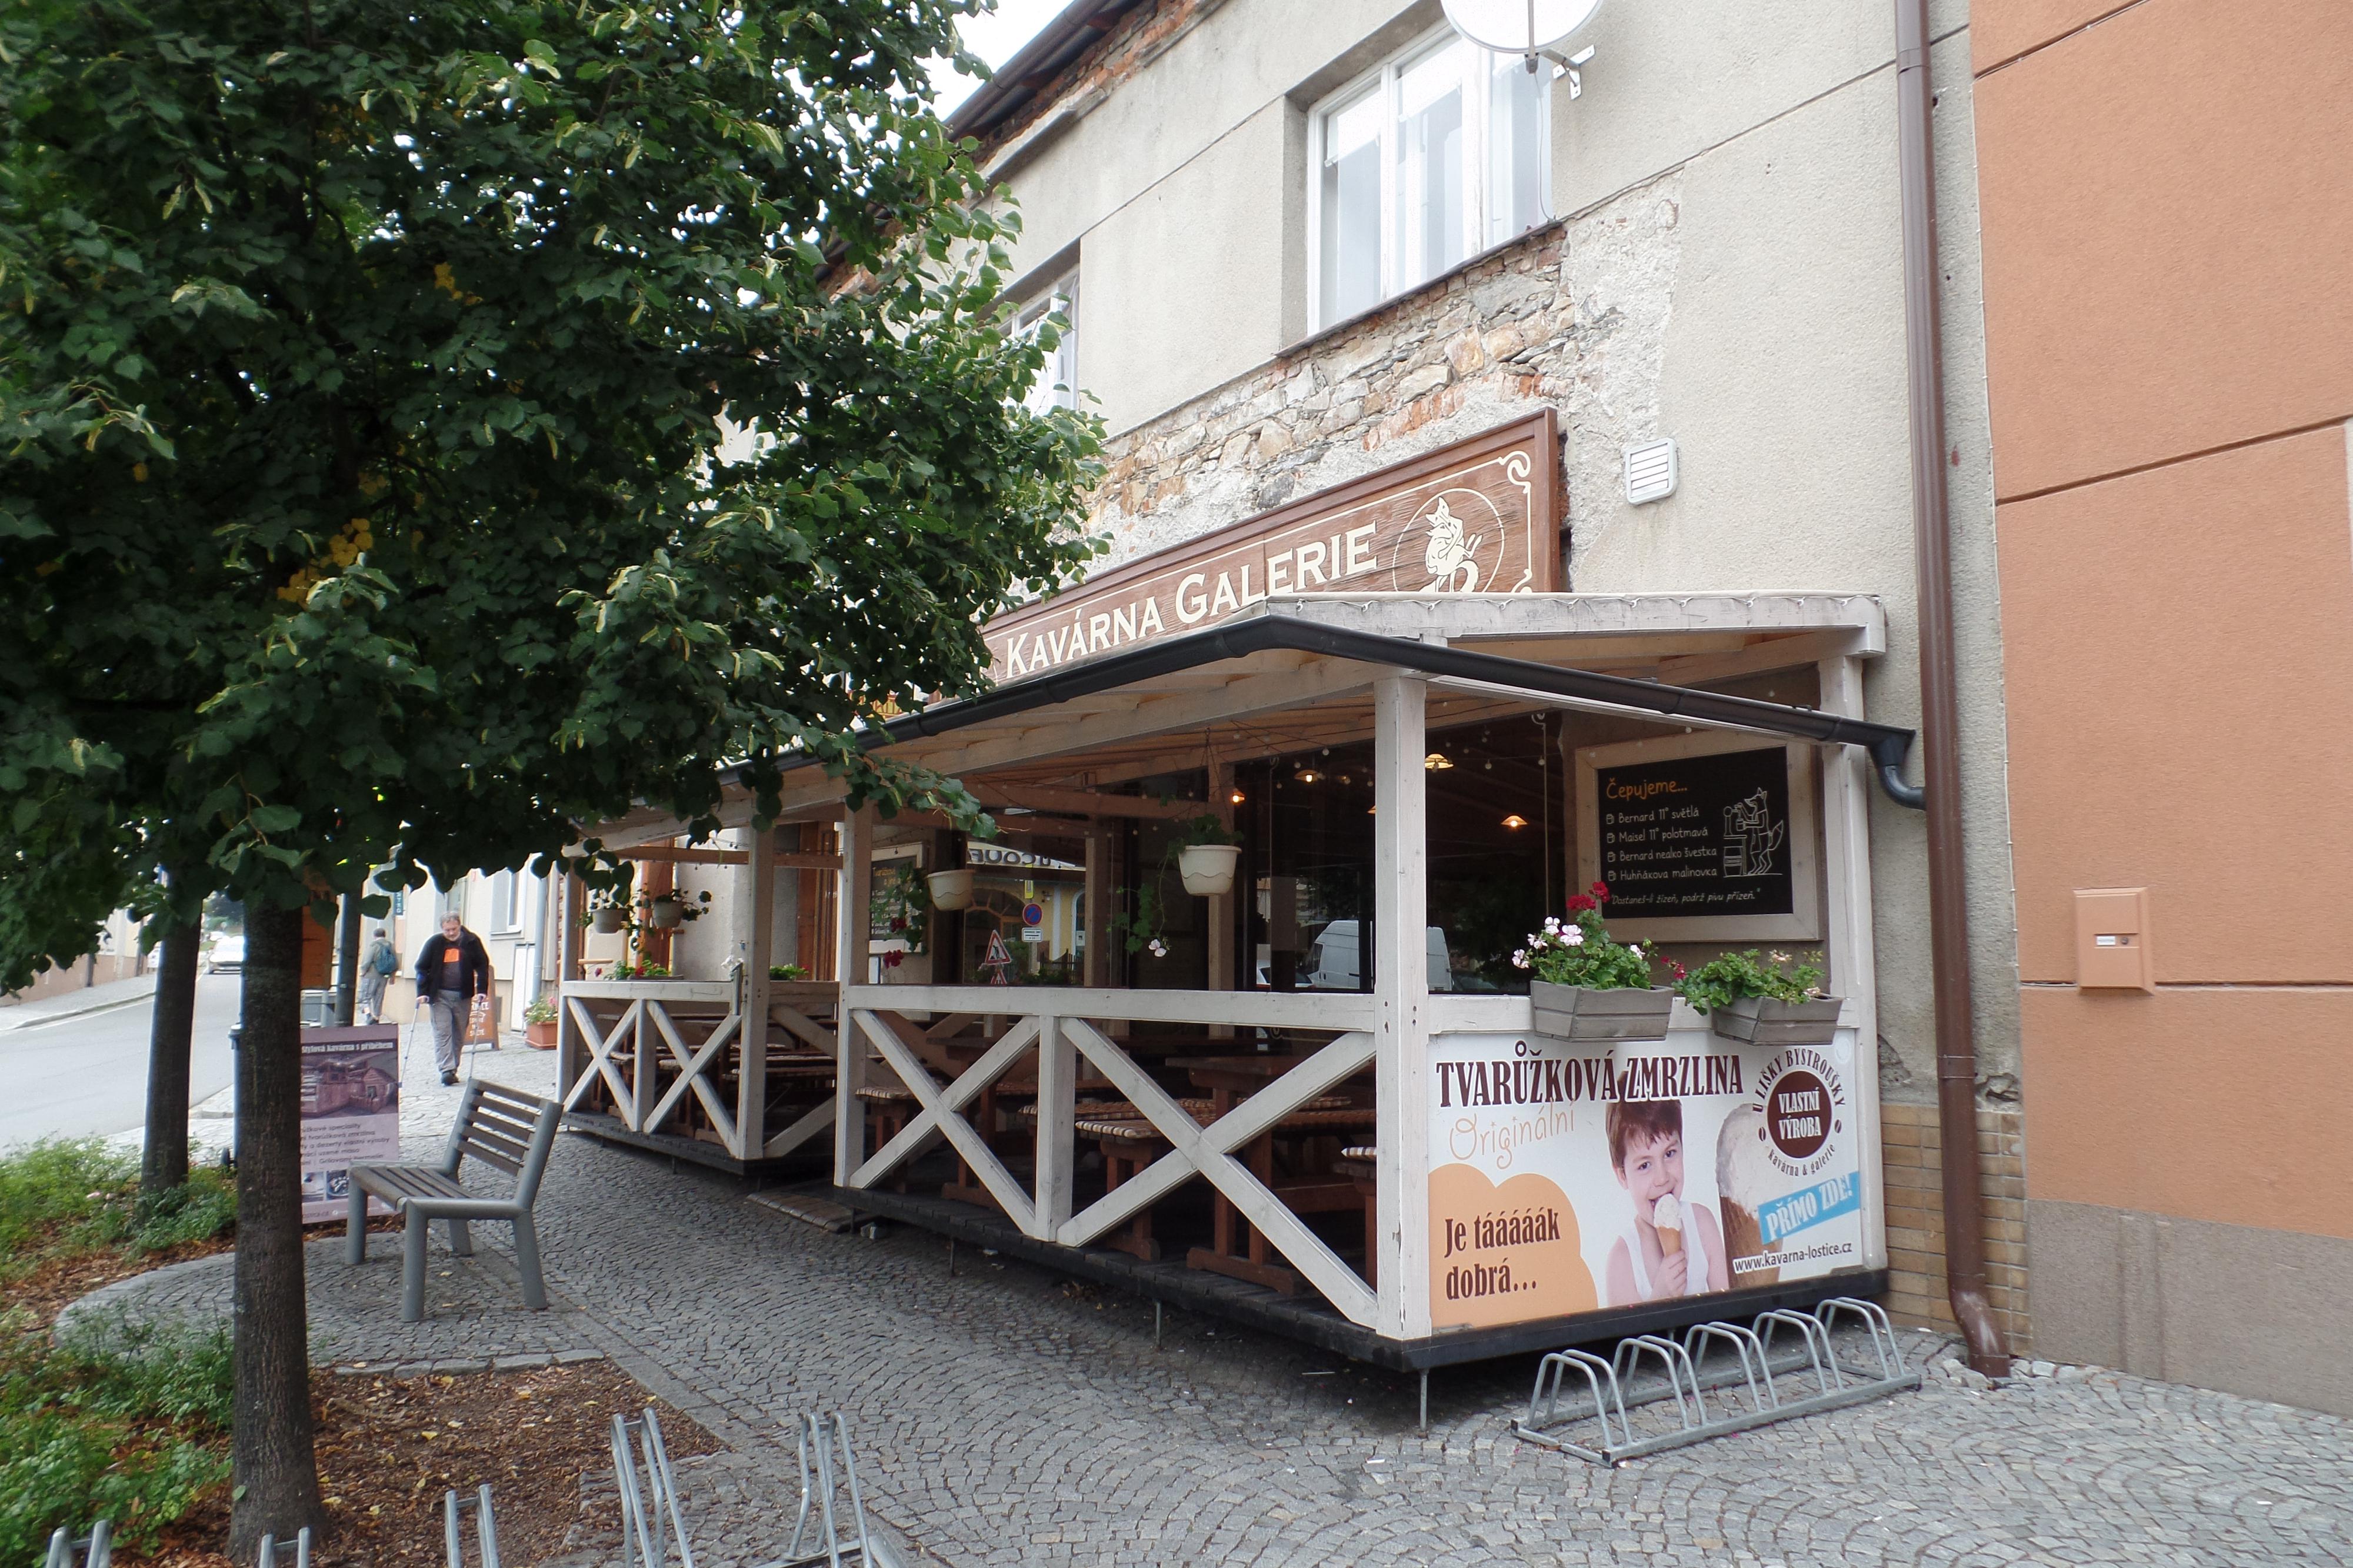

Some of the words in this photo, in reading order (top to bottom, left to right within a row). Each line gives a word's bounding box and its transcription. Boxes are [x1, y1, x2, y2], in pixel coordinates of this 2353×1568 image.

[1006, 596, 1165, 679] KAVÁRNA
[1175, 521, 1378, 623] GALERIE
[1607, 778, 1688, 800] Čepujeme...
[1618, 810, 1655, 823] Bernard
[1672, 805, 1699, 819] světlá
[1619, 829, 1645, 842] Maisel
[1662, 826, 1708, 842] polotmavá
[1619, 849, 1654, 861] Bernard
[1656, 846, 1681, 859] nealko
[1684, 846, 1717, 858] švestka
[1672, 865, 1718, 878] malinovka
[1436, 1040, 1618, 1107] TVARŮŽKOVÁ
[1625, 1055, 1744, 1099] ZMRZLINA
[1755, 1055, 1783, 1100] LIŠKY
[1785, 1049, 1845, 1106] BYSTROUŠKY
[1752, 1103, 1764, 1113] U
[1778, 1087, 1821, 1114] VLASTNÍ
[1449, 1097, 1575, 1170] Originální
[1778, 1115, 1822, 1140] VÝROBA
[1768, 1149, 1799, 1176] kavárna
[1802, 1165, 1808, 1176] &
[1811, 1144, 1835, 1175] galerie
[1765, 1192, 1818, 1241] PŘÍMO
[1819, 1175, 1853, 1210] ZDE!
[1444, 1218, 1467, 1258] Je
[1474, 1207, 1560, 1249] tááááák
[1734, 1243, 1852, 1271] www.kavarna-lostice.cz
[1446, 1257, 1537, 1300] dobrá...
